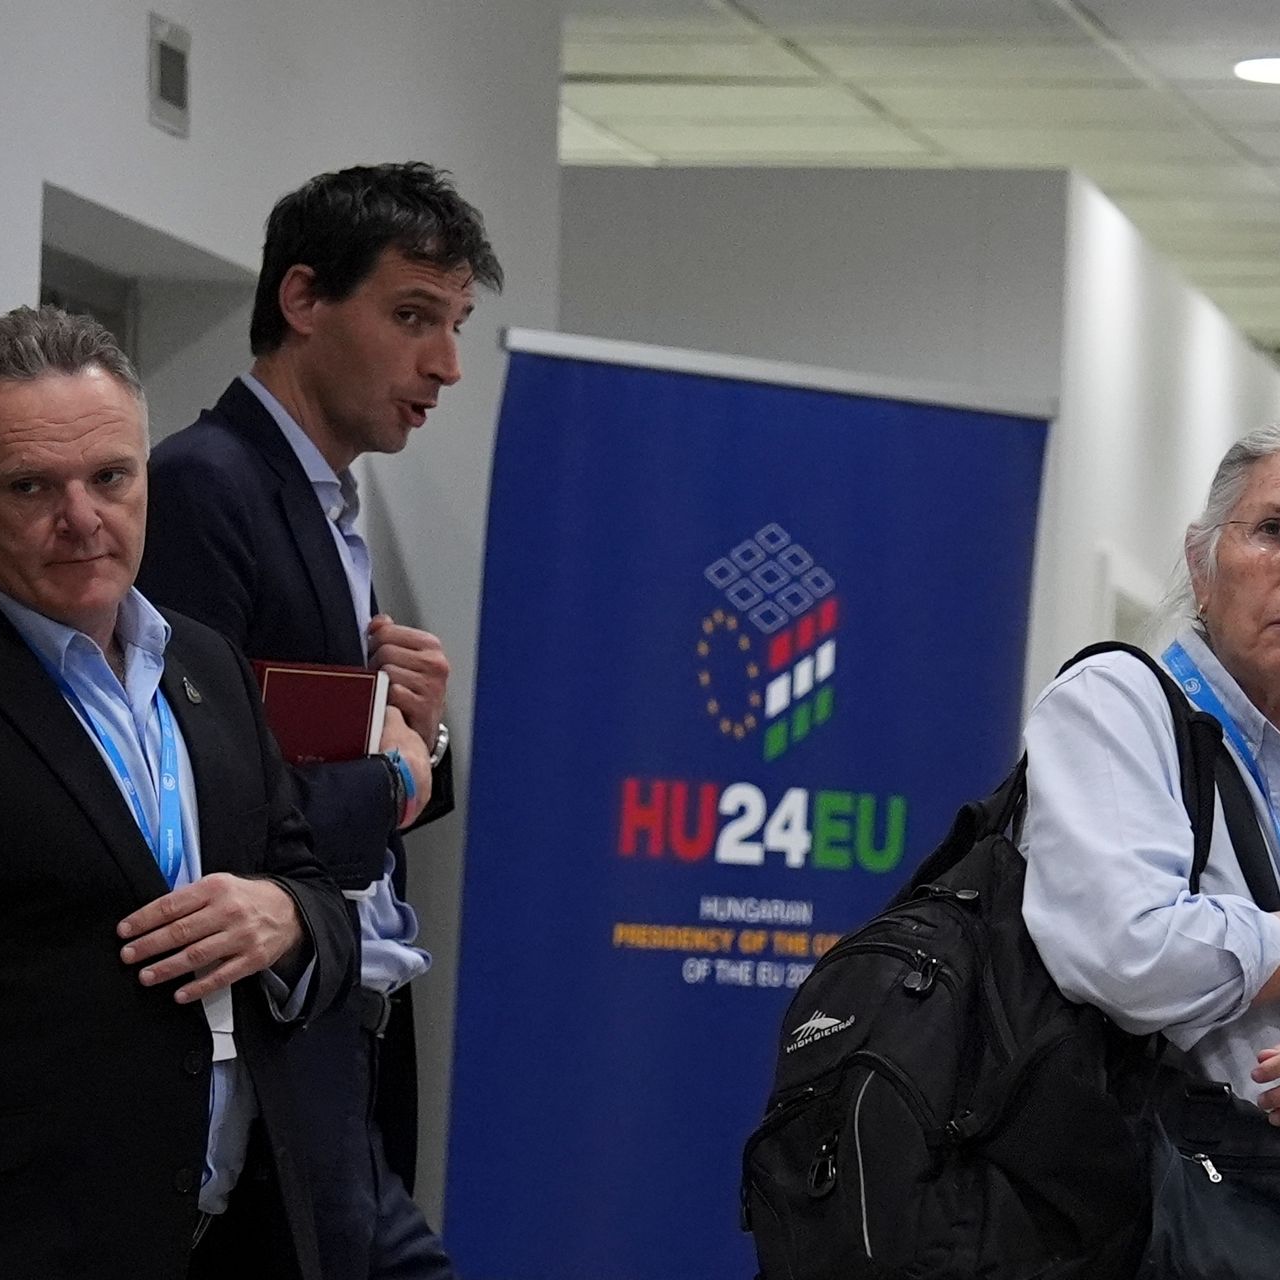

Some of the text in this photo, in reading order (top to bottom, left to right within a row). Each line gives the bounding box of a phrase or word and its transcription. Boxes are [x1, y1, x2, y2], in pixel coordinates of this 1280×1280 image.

[618, 776, 908, 874] HU24EU
[738, 929, 768, 955] OF
[681, 956, 713, 984] OF
[714, 958, 756, 986] THE
[786, 1035, 813, 1053] HIGH
